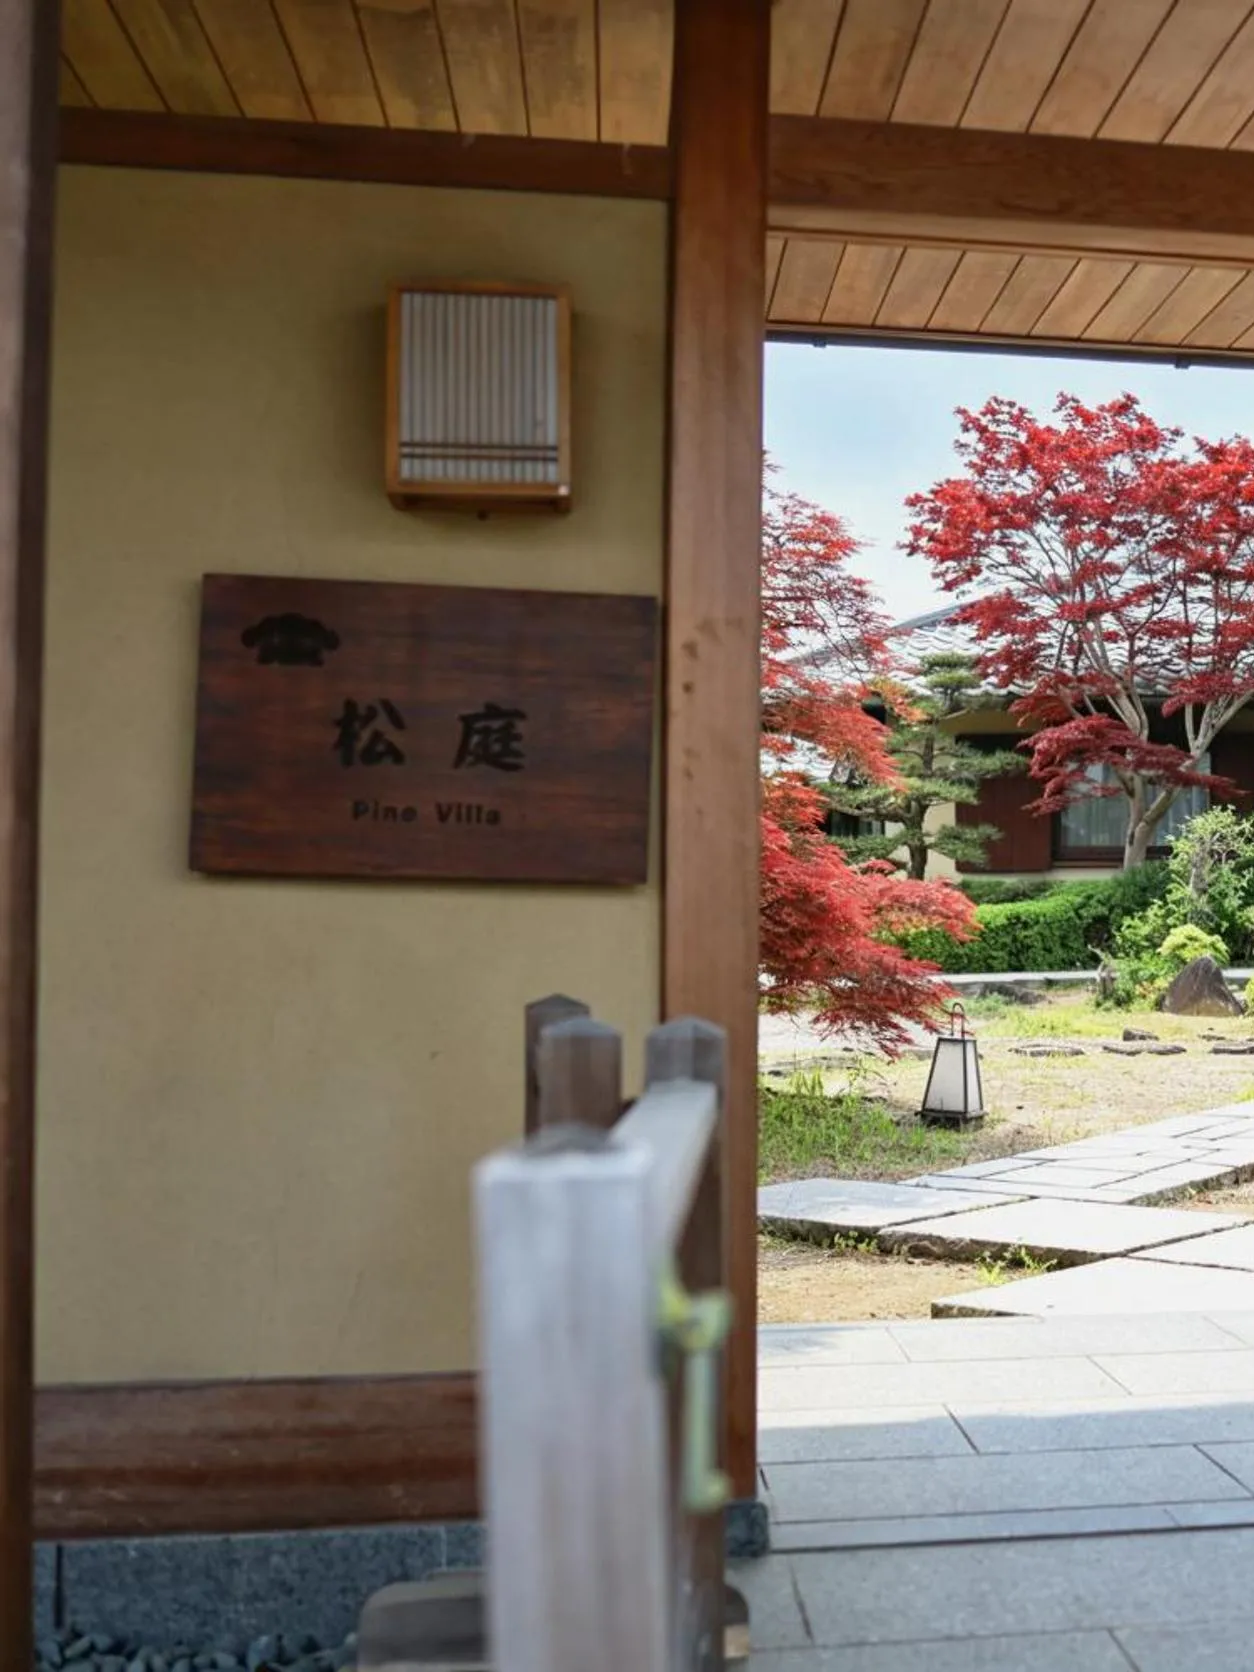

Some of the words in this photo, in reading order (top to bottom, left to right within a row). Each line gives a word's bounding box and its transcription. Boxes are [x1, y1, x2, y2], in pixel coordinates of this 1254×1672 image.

[333, 697, 527, 773] 松庭
[352, 800, 418, 823] Pine
[434, 802, 503, 826] Villa
